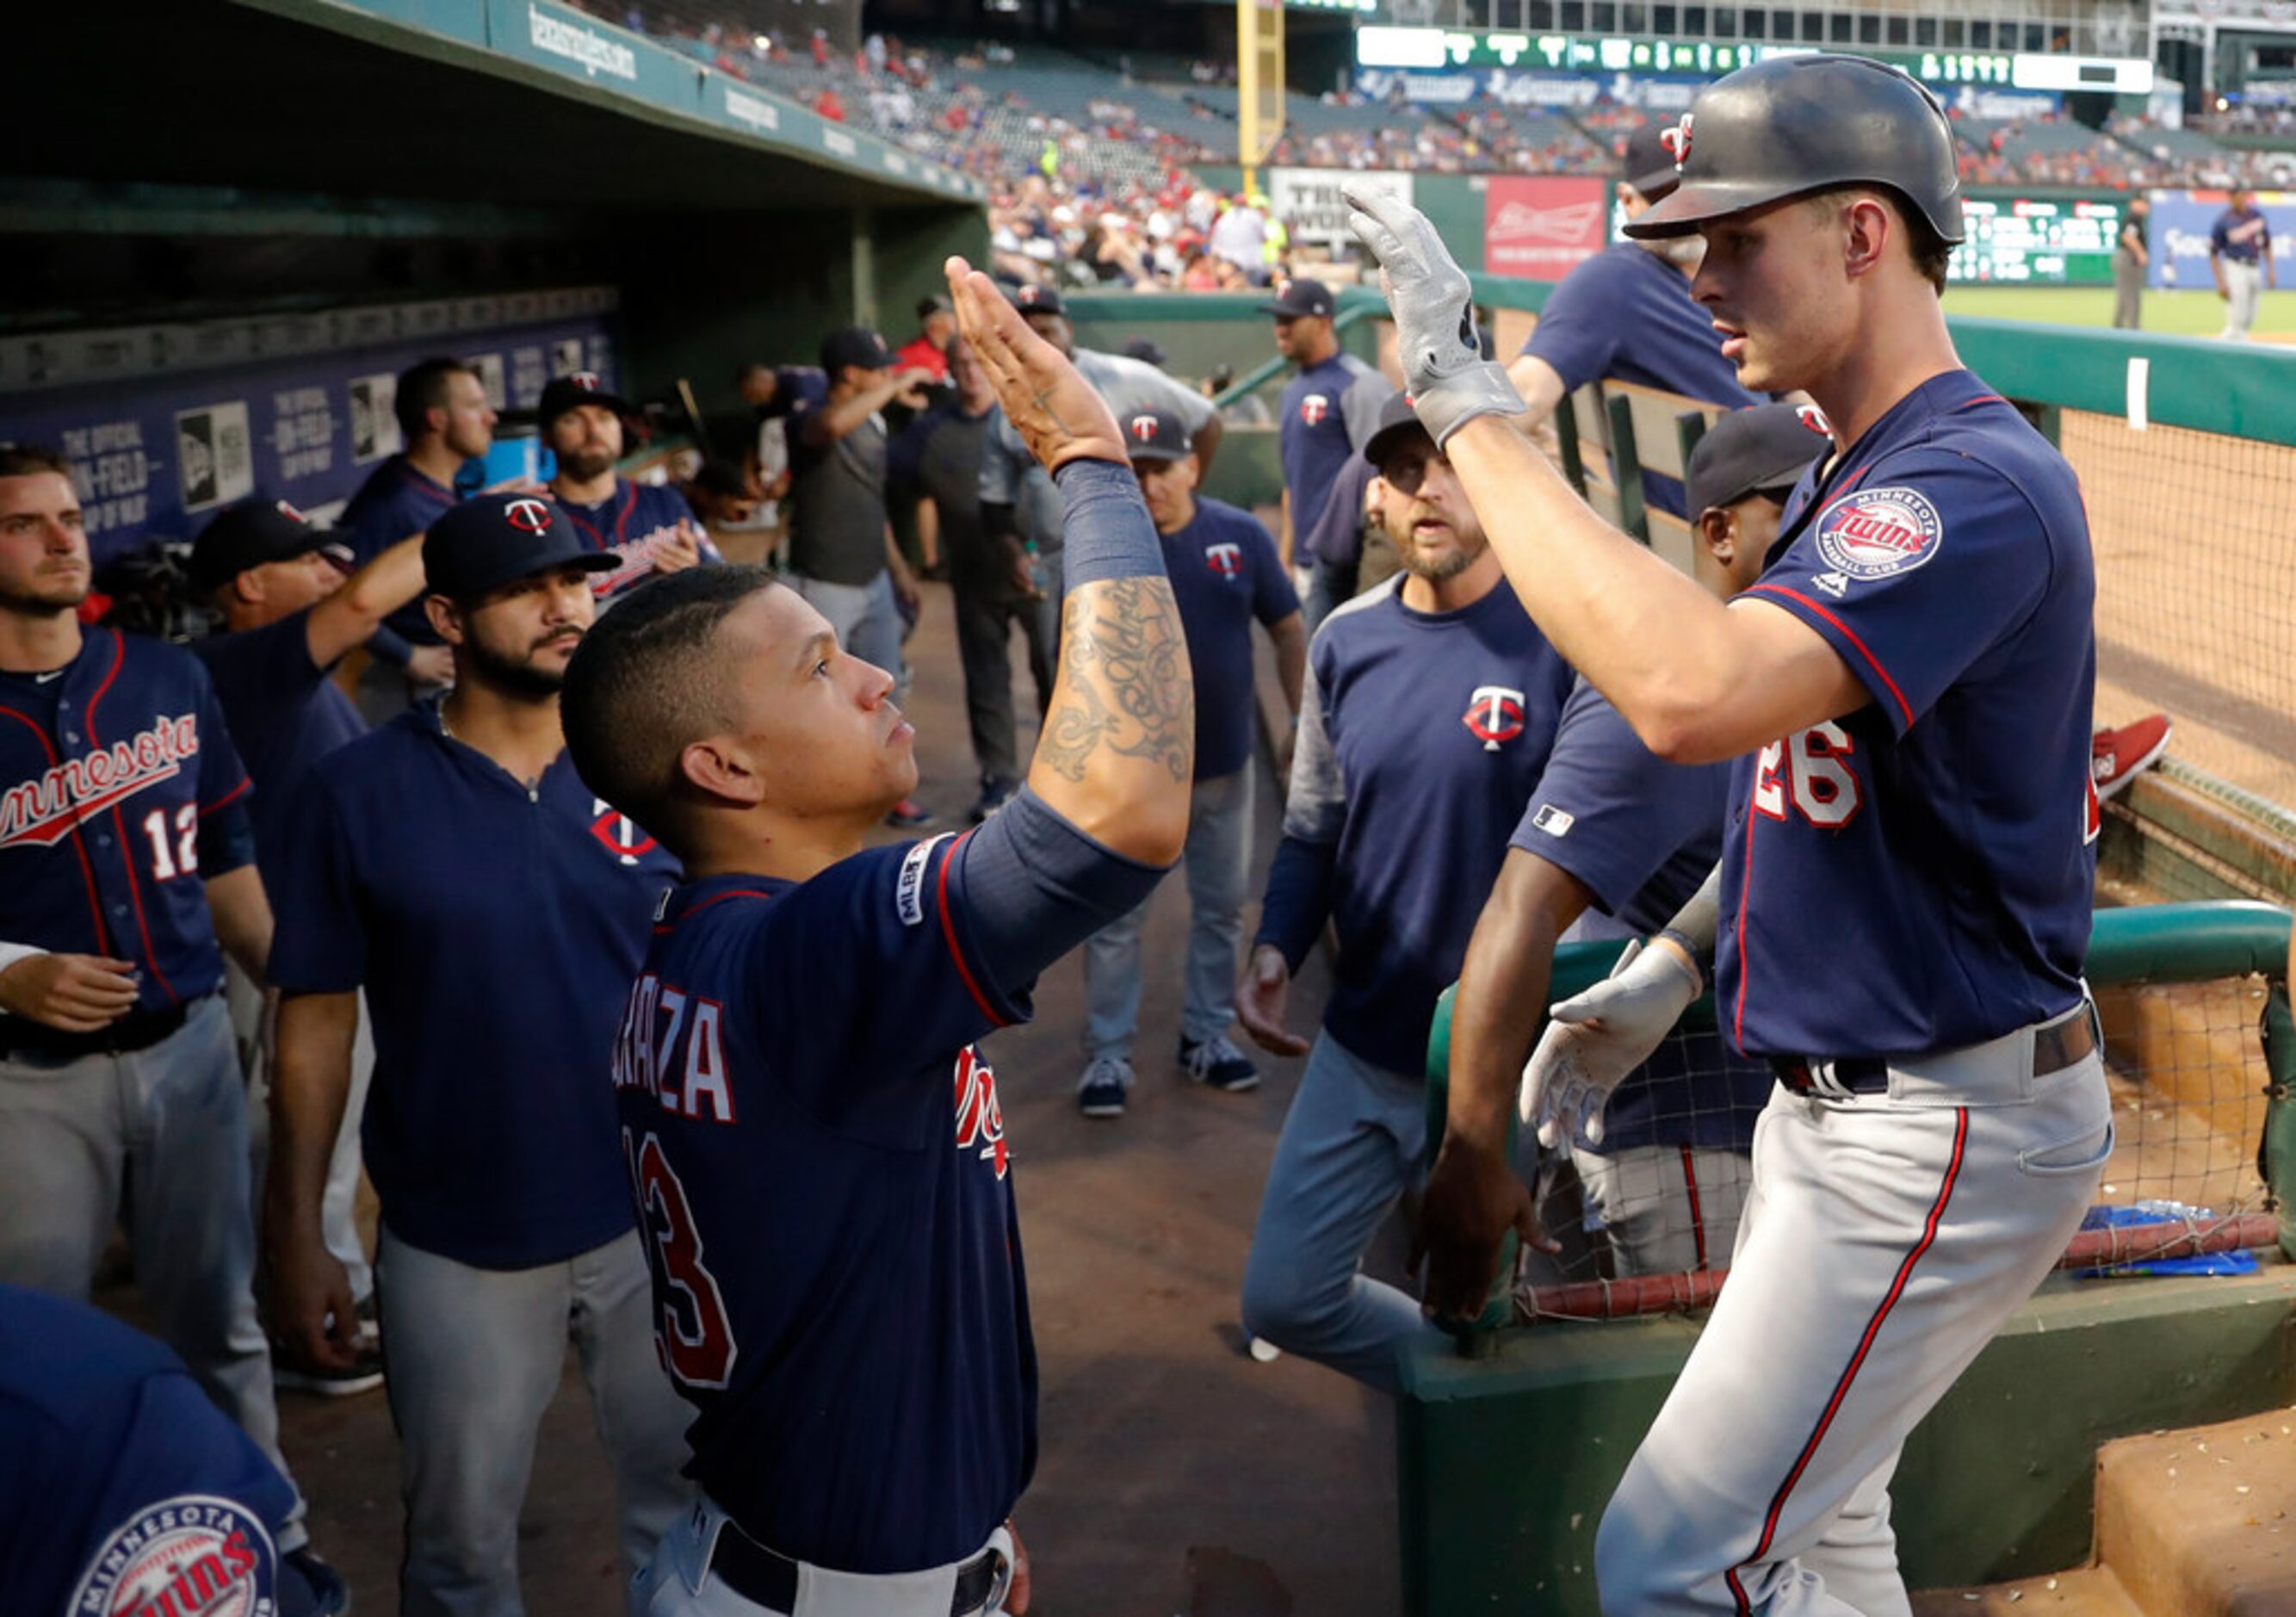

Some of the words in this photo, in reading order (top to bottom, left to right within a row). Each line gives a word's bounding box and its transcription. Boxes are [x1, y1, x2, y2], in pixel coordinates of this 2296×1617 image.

[1830, 506, 1931, 554] Twins
[1856, 491, 1935, 536] MINNESOTA
[144, 801, 197, 882] 12
[84, 1507, 234, 1612] MINNESOTA
